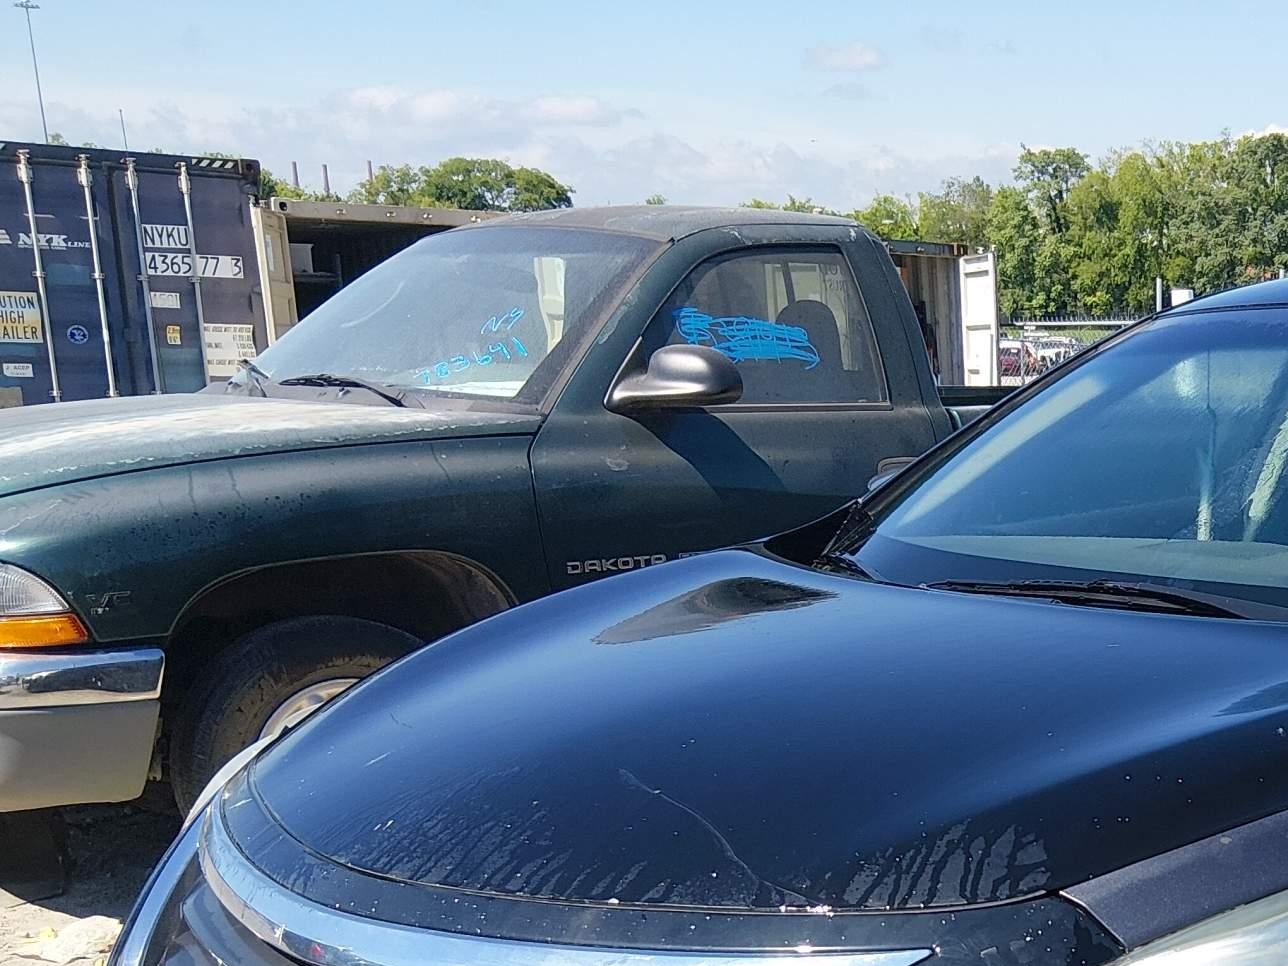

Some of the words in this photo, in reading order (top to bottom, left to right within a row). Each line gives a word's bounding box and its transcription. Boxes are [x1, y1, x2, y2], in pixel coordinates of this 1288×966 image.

[18, 232, 68, 247] NYK
[67, 241, 92, 249] LINE
[142, 226, 189, 247] NYKU
[566, 553, 667, 574] DAKOTA
